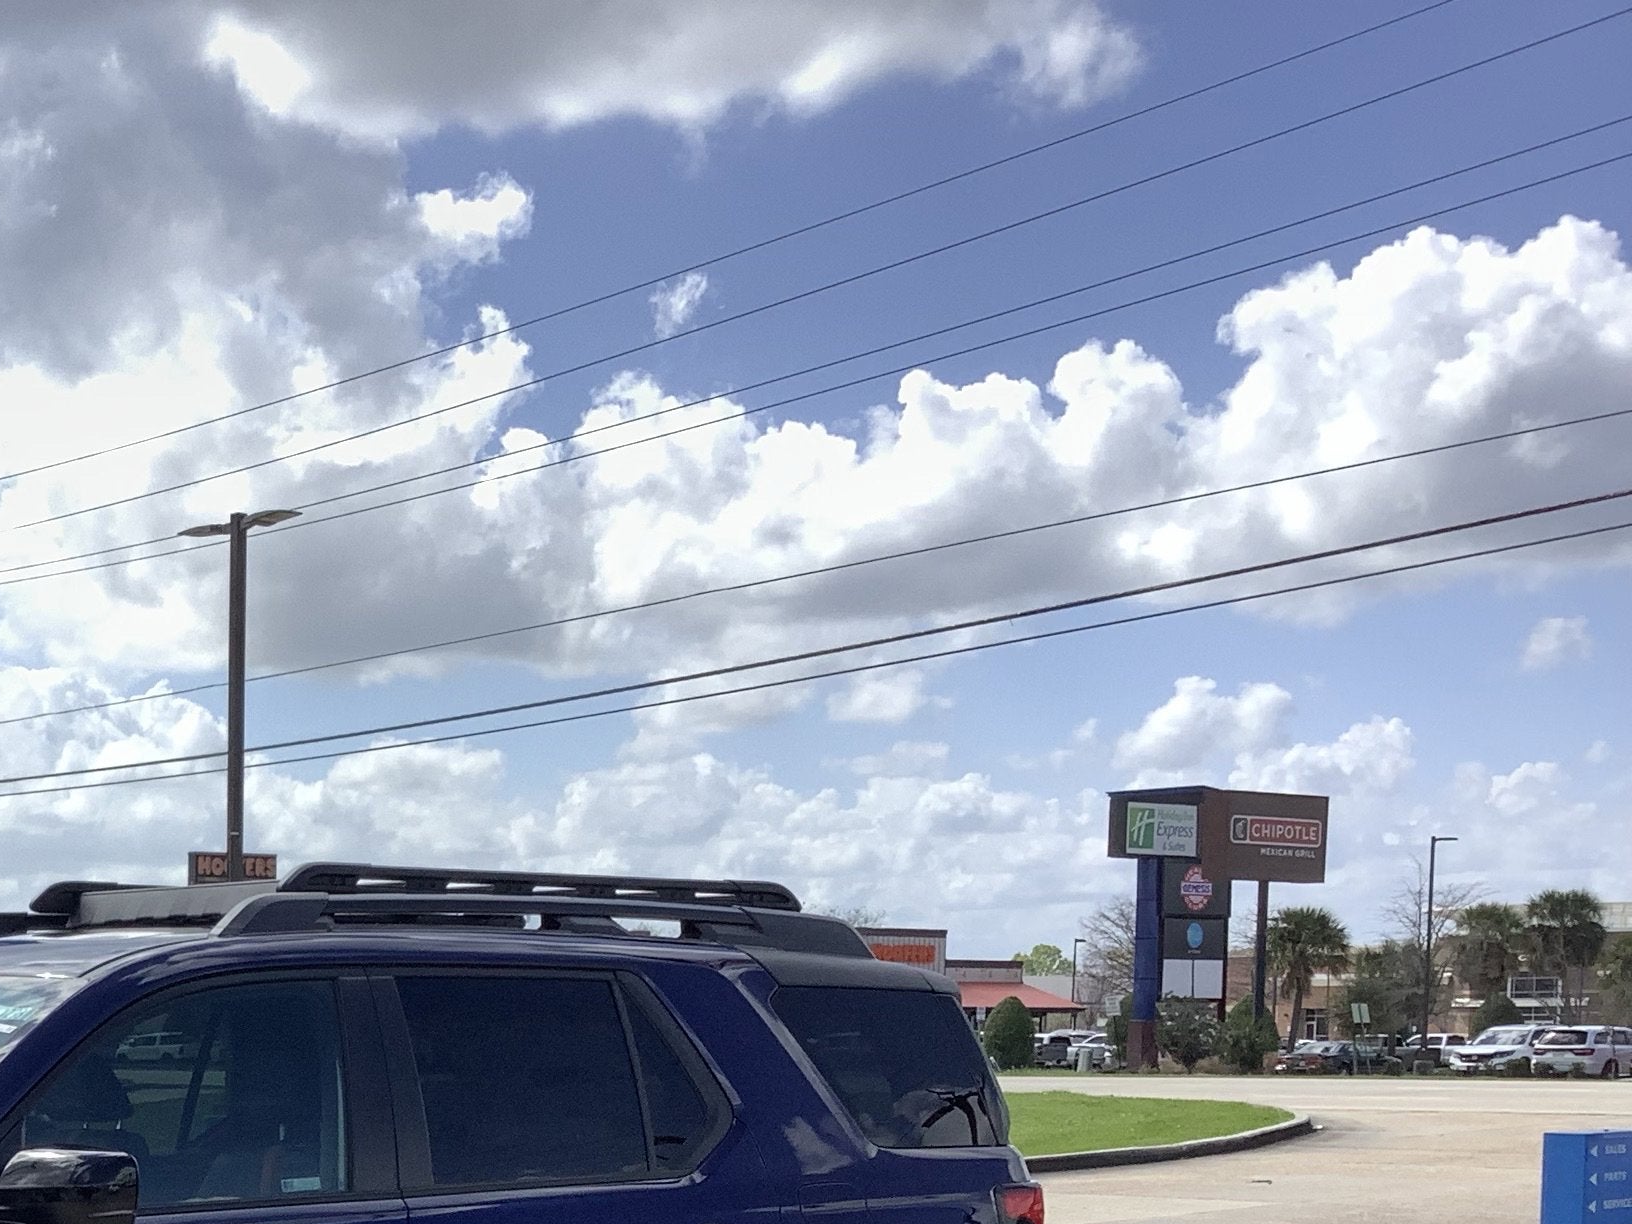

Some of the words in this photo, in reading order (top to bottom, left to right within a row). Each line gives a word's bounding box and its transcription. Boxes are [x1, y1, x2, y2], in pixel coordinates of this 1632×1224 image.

[1156, 821, 1194, 840] Express
[1251, 823, 1318, 841] CHIPOTLE
[1260, 847, 1294, 857] MEXICAN
[1295, 849, 1316, 859] GRILL
[1604, 1171, 1627, 1181] PARTS
